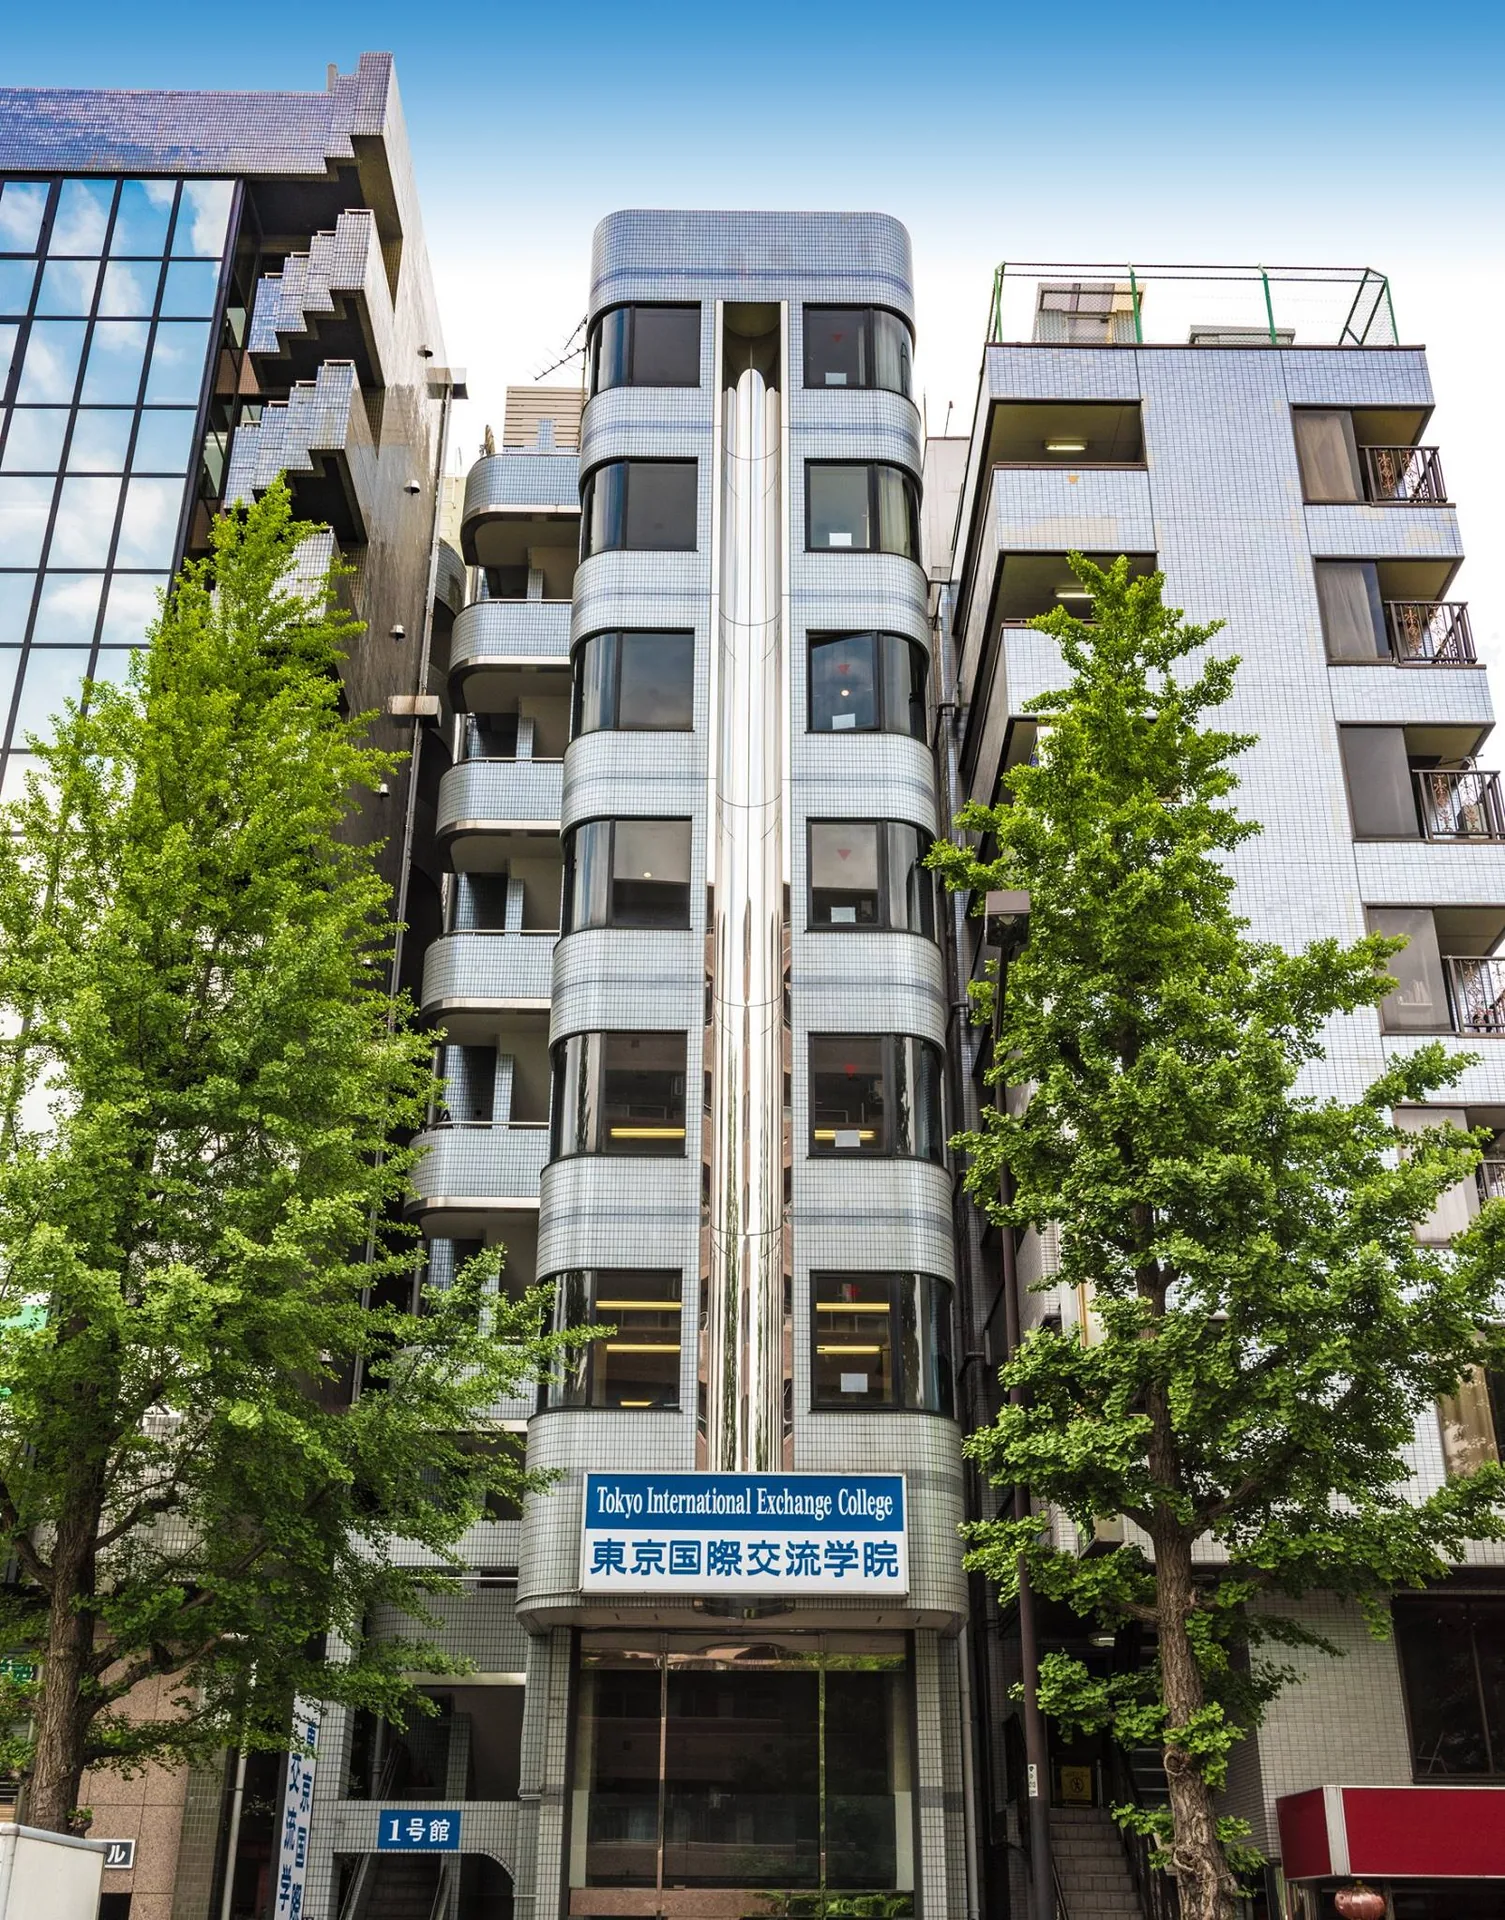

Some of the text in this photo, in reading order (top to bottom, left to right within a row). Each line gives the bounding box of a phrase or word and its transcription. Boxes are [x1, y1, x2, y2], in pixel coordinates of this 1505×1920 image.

[597, 1486, 893, 1523] Tokyo International Exchange College
[589, 1537, 900, 1578] 東京国際交流学院
[387, 1818, 452, 1843] 1号館
